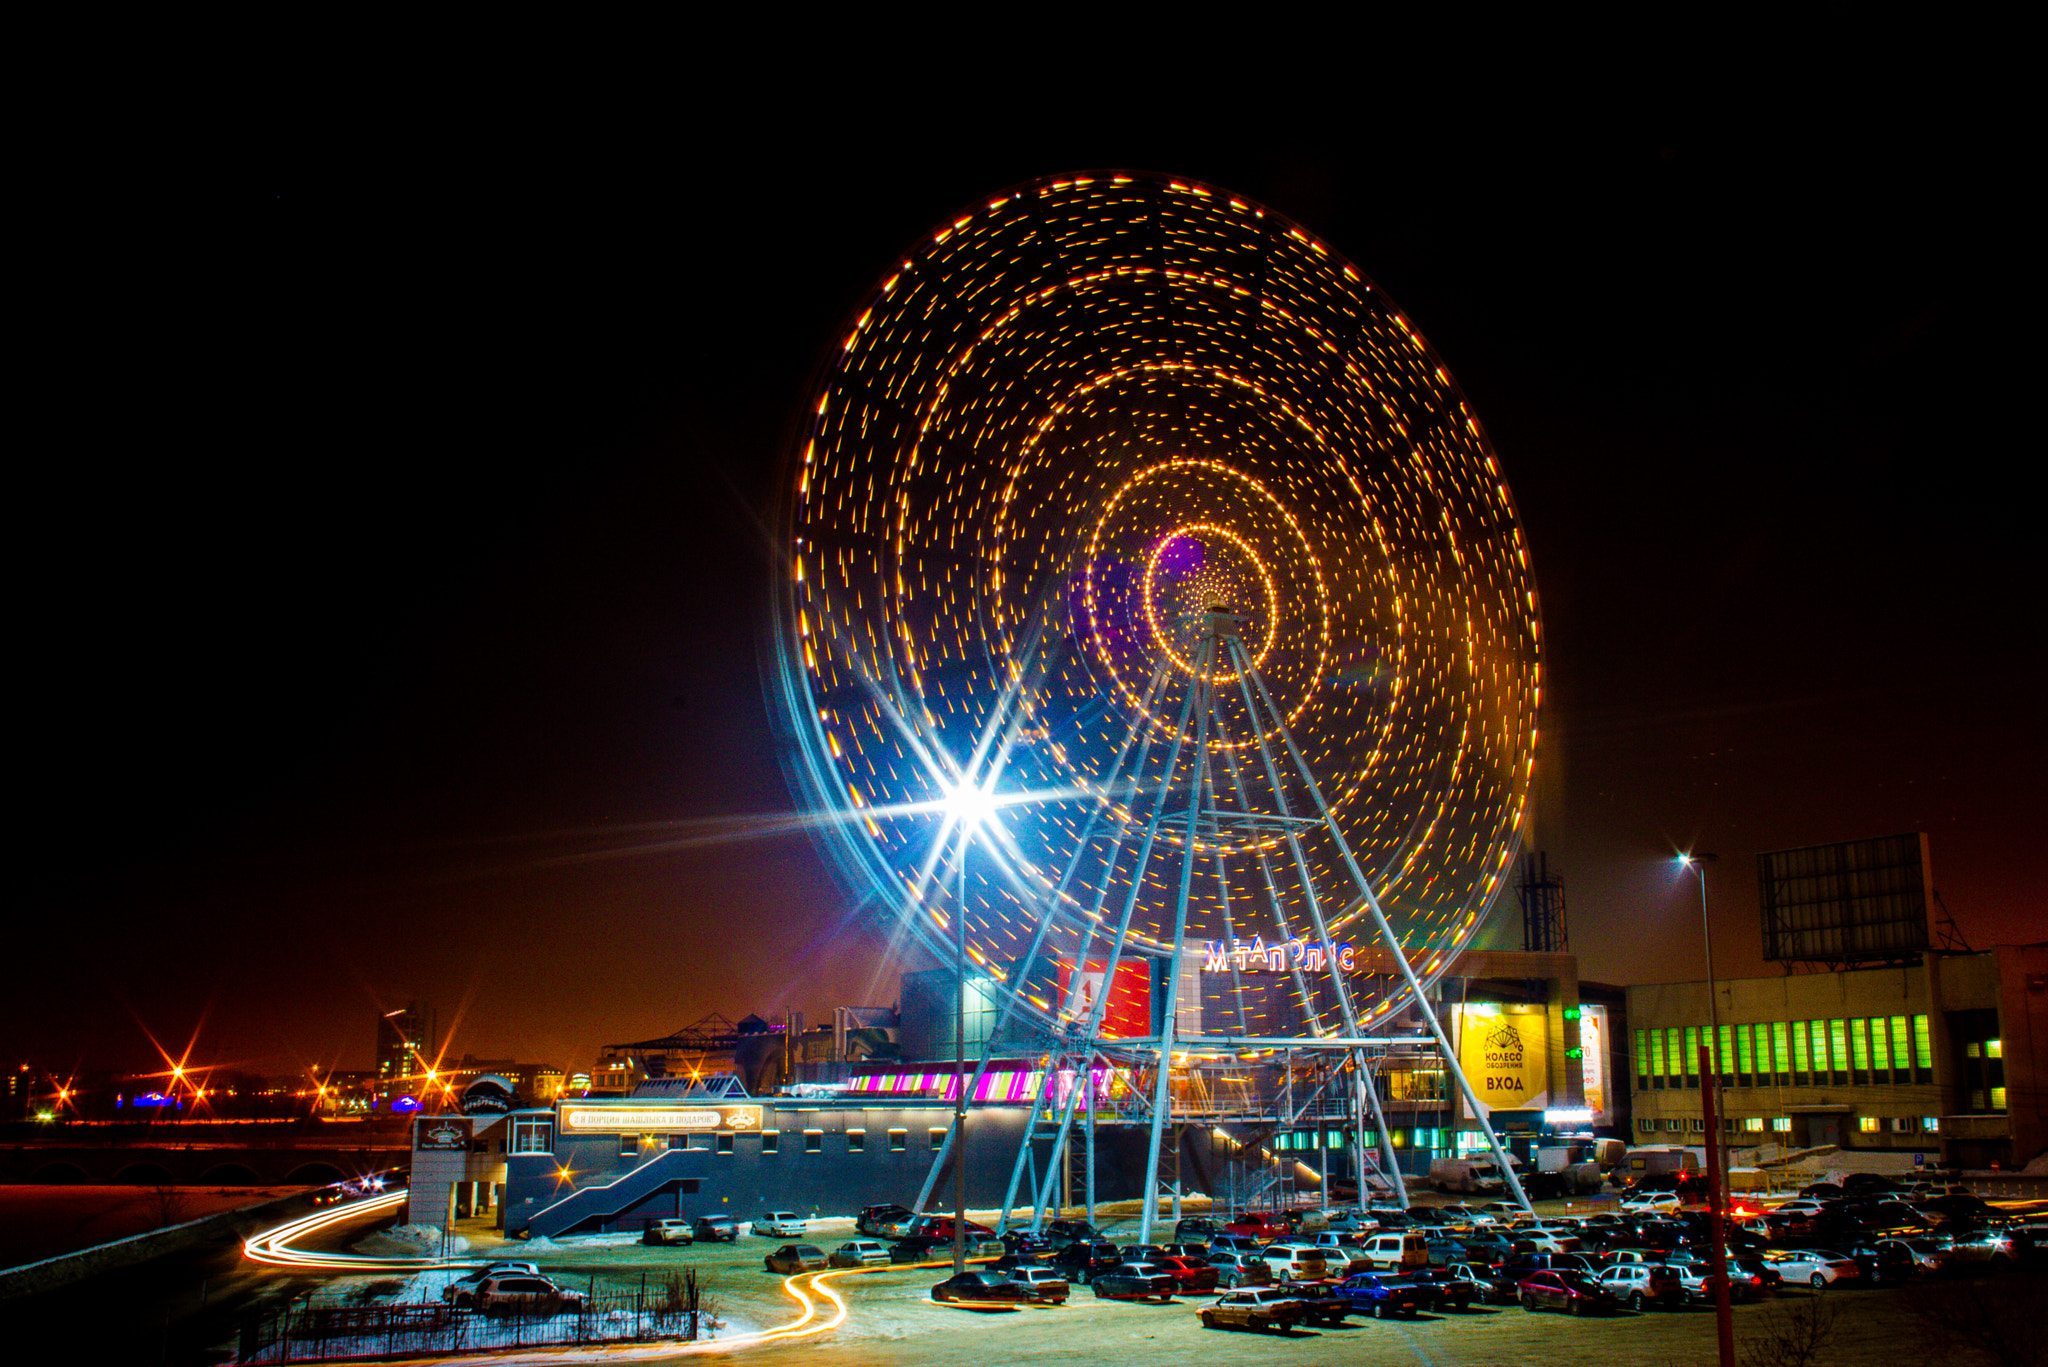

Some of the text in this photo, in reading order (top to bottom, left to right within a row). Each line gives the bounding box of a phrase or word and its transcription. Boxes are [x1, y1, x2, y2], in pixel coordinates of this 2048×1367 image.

[1486, 1052, 1522, 1061] КОЛЕСО
[1487, 1076, 1524, 1091] ВХОД
[588, 1115, 620, 1125] ПОРЦИЯ
[622, 1115, 666, 1124] ШАШЛЫКА
[669, 1115, 674, 1124] В
[676, 1115, 715, 1125] ПОДАРОК!
